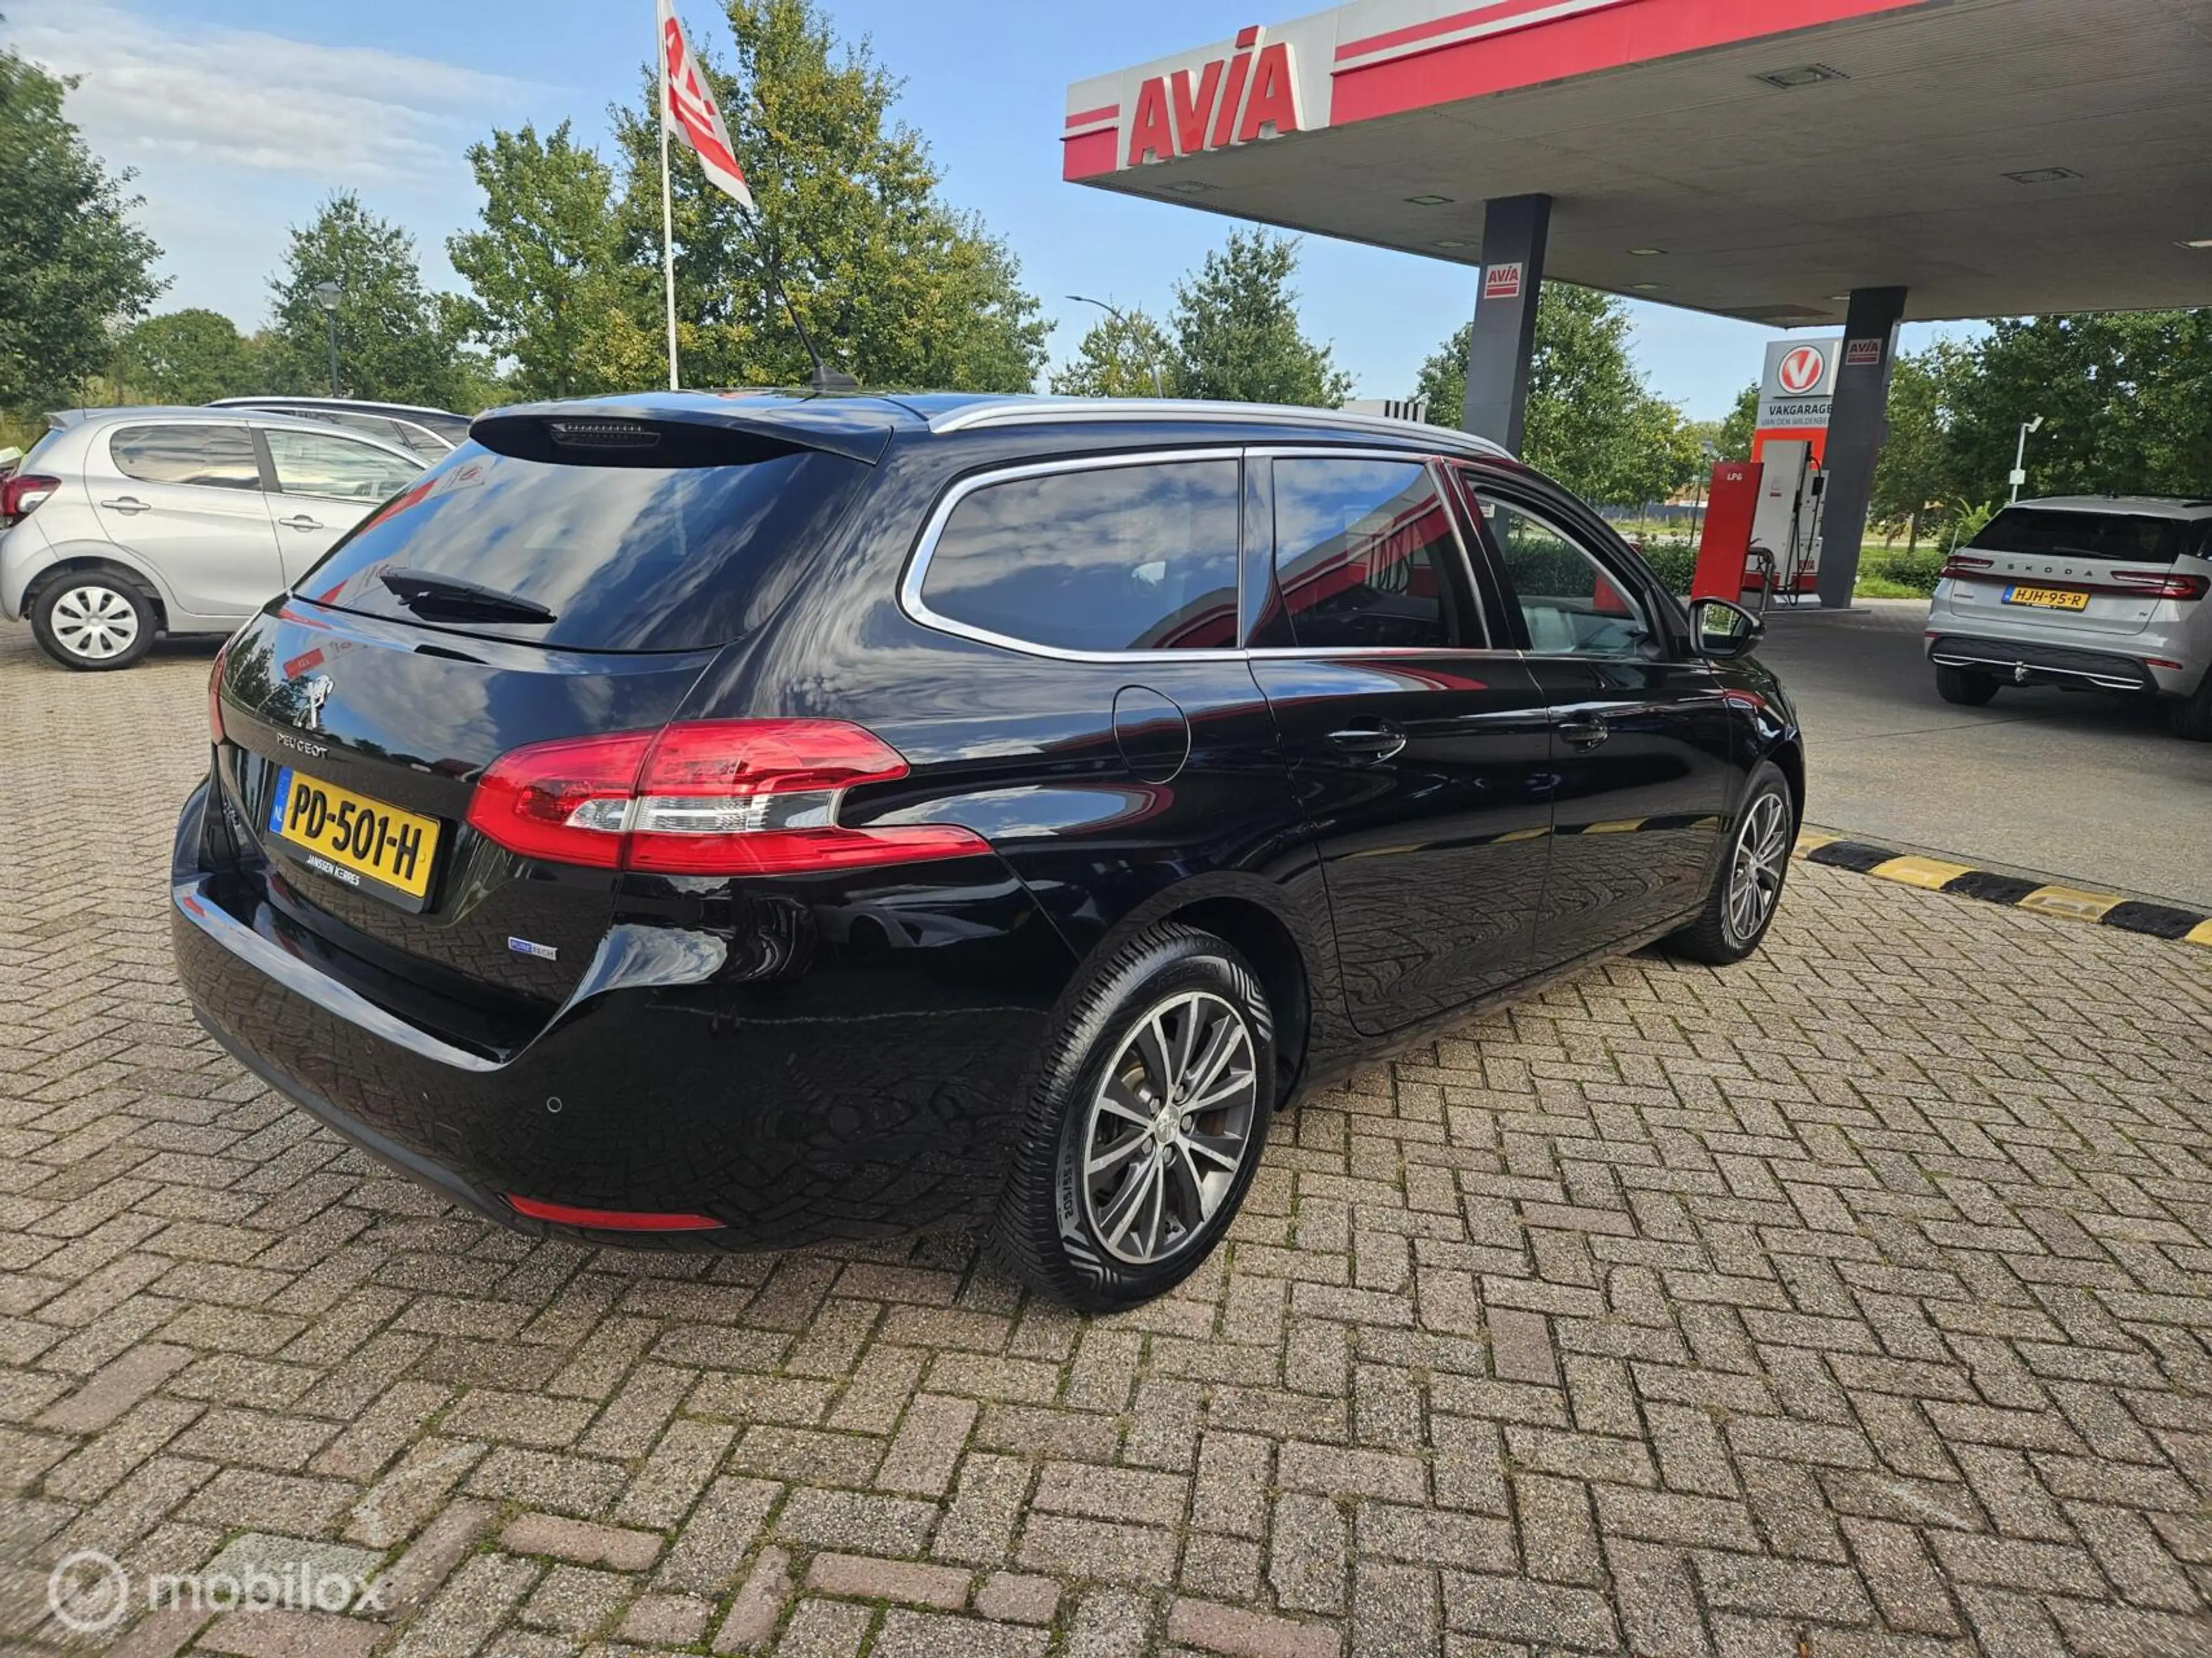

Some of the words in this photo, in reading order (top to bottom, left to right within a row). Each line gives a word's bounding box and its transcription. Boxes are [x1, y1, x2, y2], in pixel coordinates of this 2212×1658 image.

[1769, 404, 1832, 415] VAKGARAGE
[1762, 417, 1775, 426] VAN
[1777, 417, 1791, 426] DEN
[2015, 589, 2082, 606] HJH-95-R
[277, 732, 328, 759] PEUGEOT
[274, 806, 282, 822] NL
[289, 783, 422, 881] PD-501-H
[306, 853, 335, 875] JANSSEN
